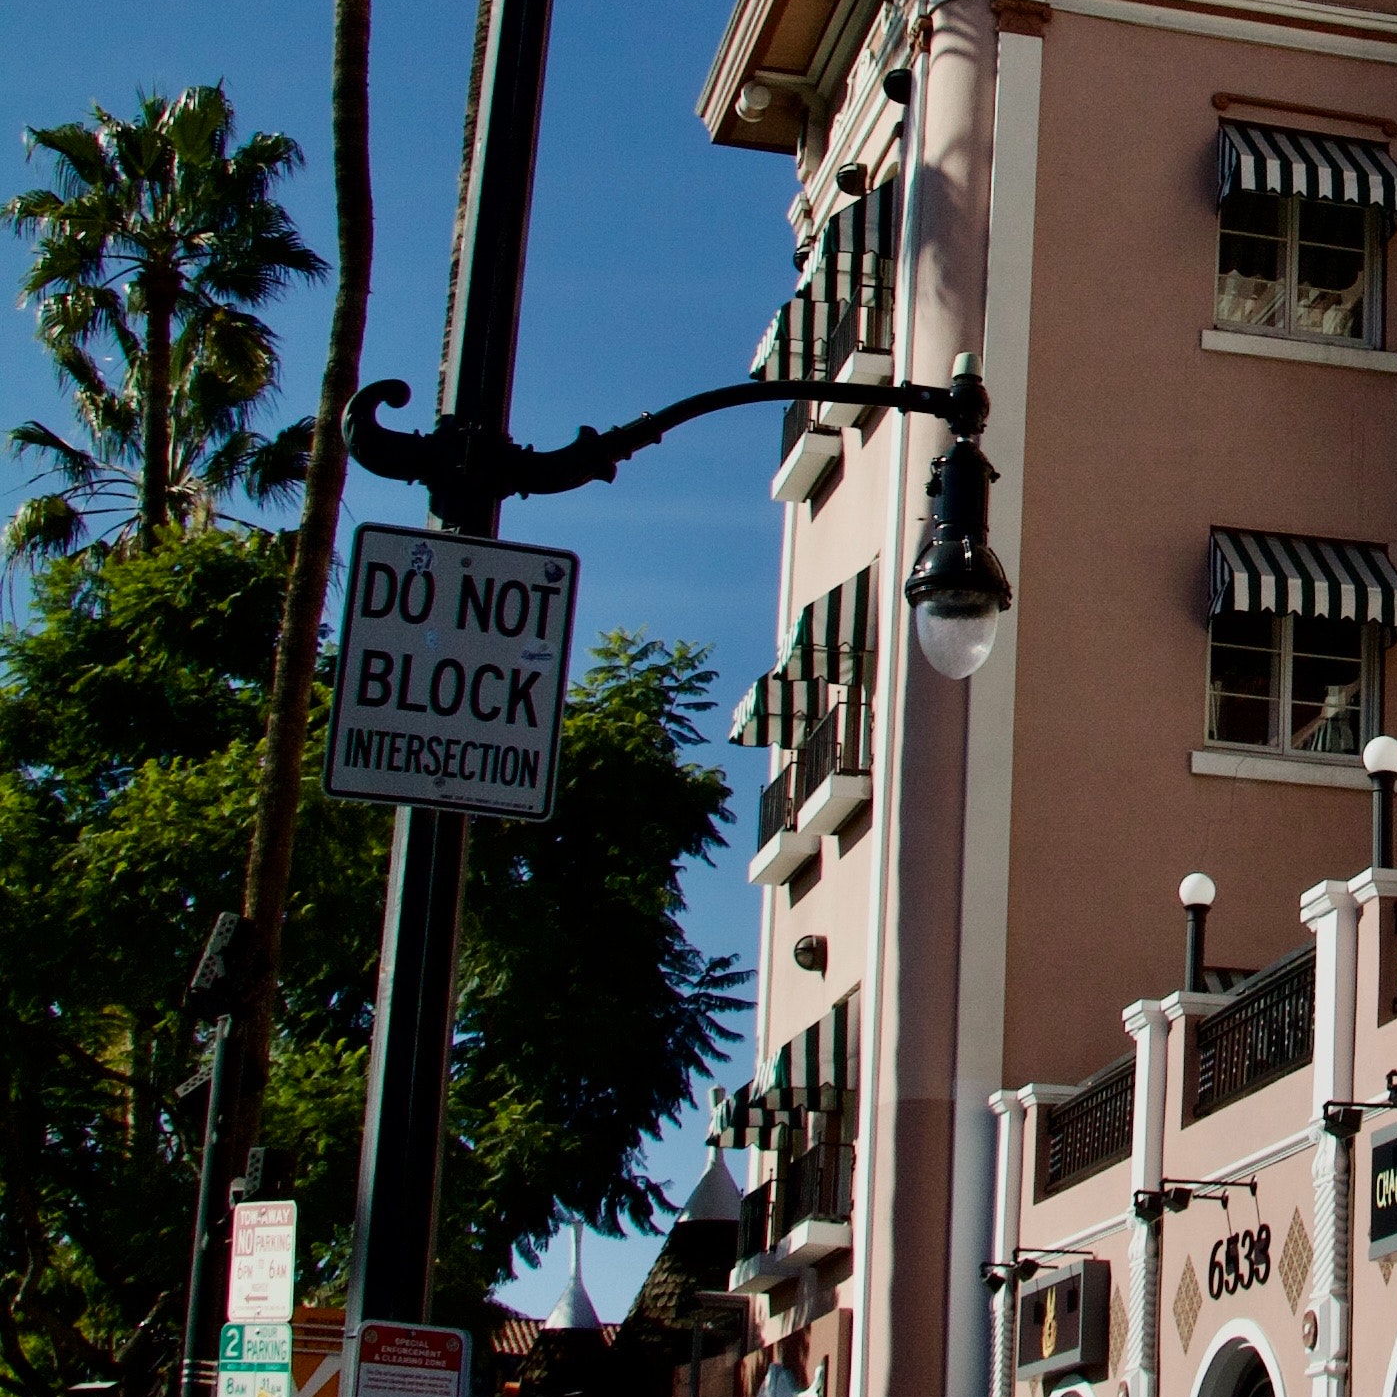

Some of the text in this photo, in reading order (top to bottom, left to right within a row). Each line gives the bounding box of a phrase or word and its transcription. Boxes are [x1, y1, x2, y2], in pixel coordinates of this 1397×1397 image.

[361, 562, 562, 640] DO NOT
[356, 649, 541, 728] BLOCK
[344, 727, 540, 789] INTERSECTION
[240, 1208, 291, 1225] TOW-AWAY
[237, 1228, 291, 1255] NO PARKING
[224, 1327, 240, 1358] 2
[247, 1339, 287, 1361] PARKING
[380, 1345, 443, 1359] ENFORCEMENT
[394, 1338, 430, 1349] SPECIAL
[374, 1354, 447, 1368] & CLEANING ZONE
